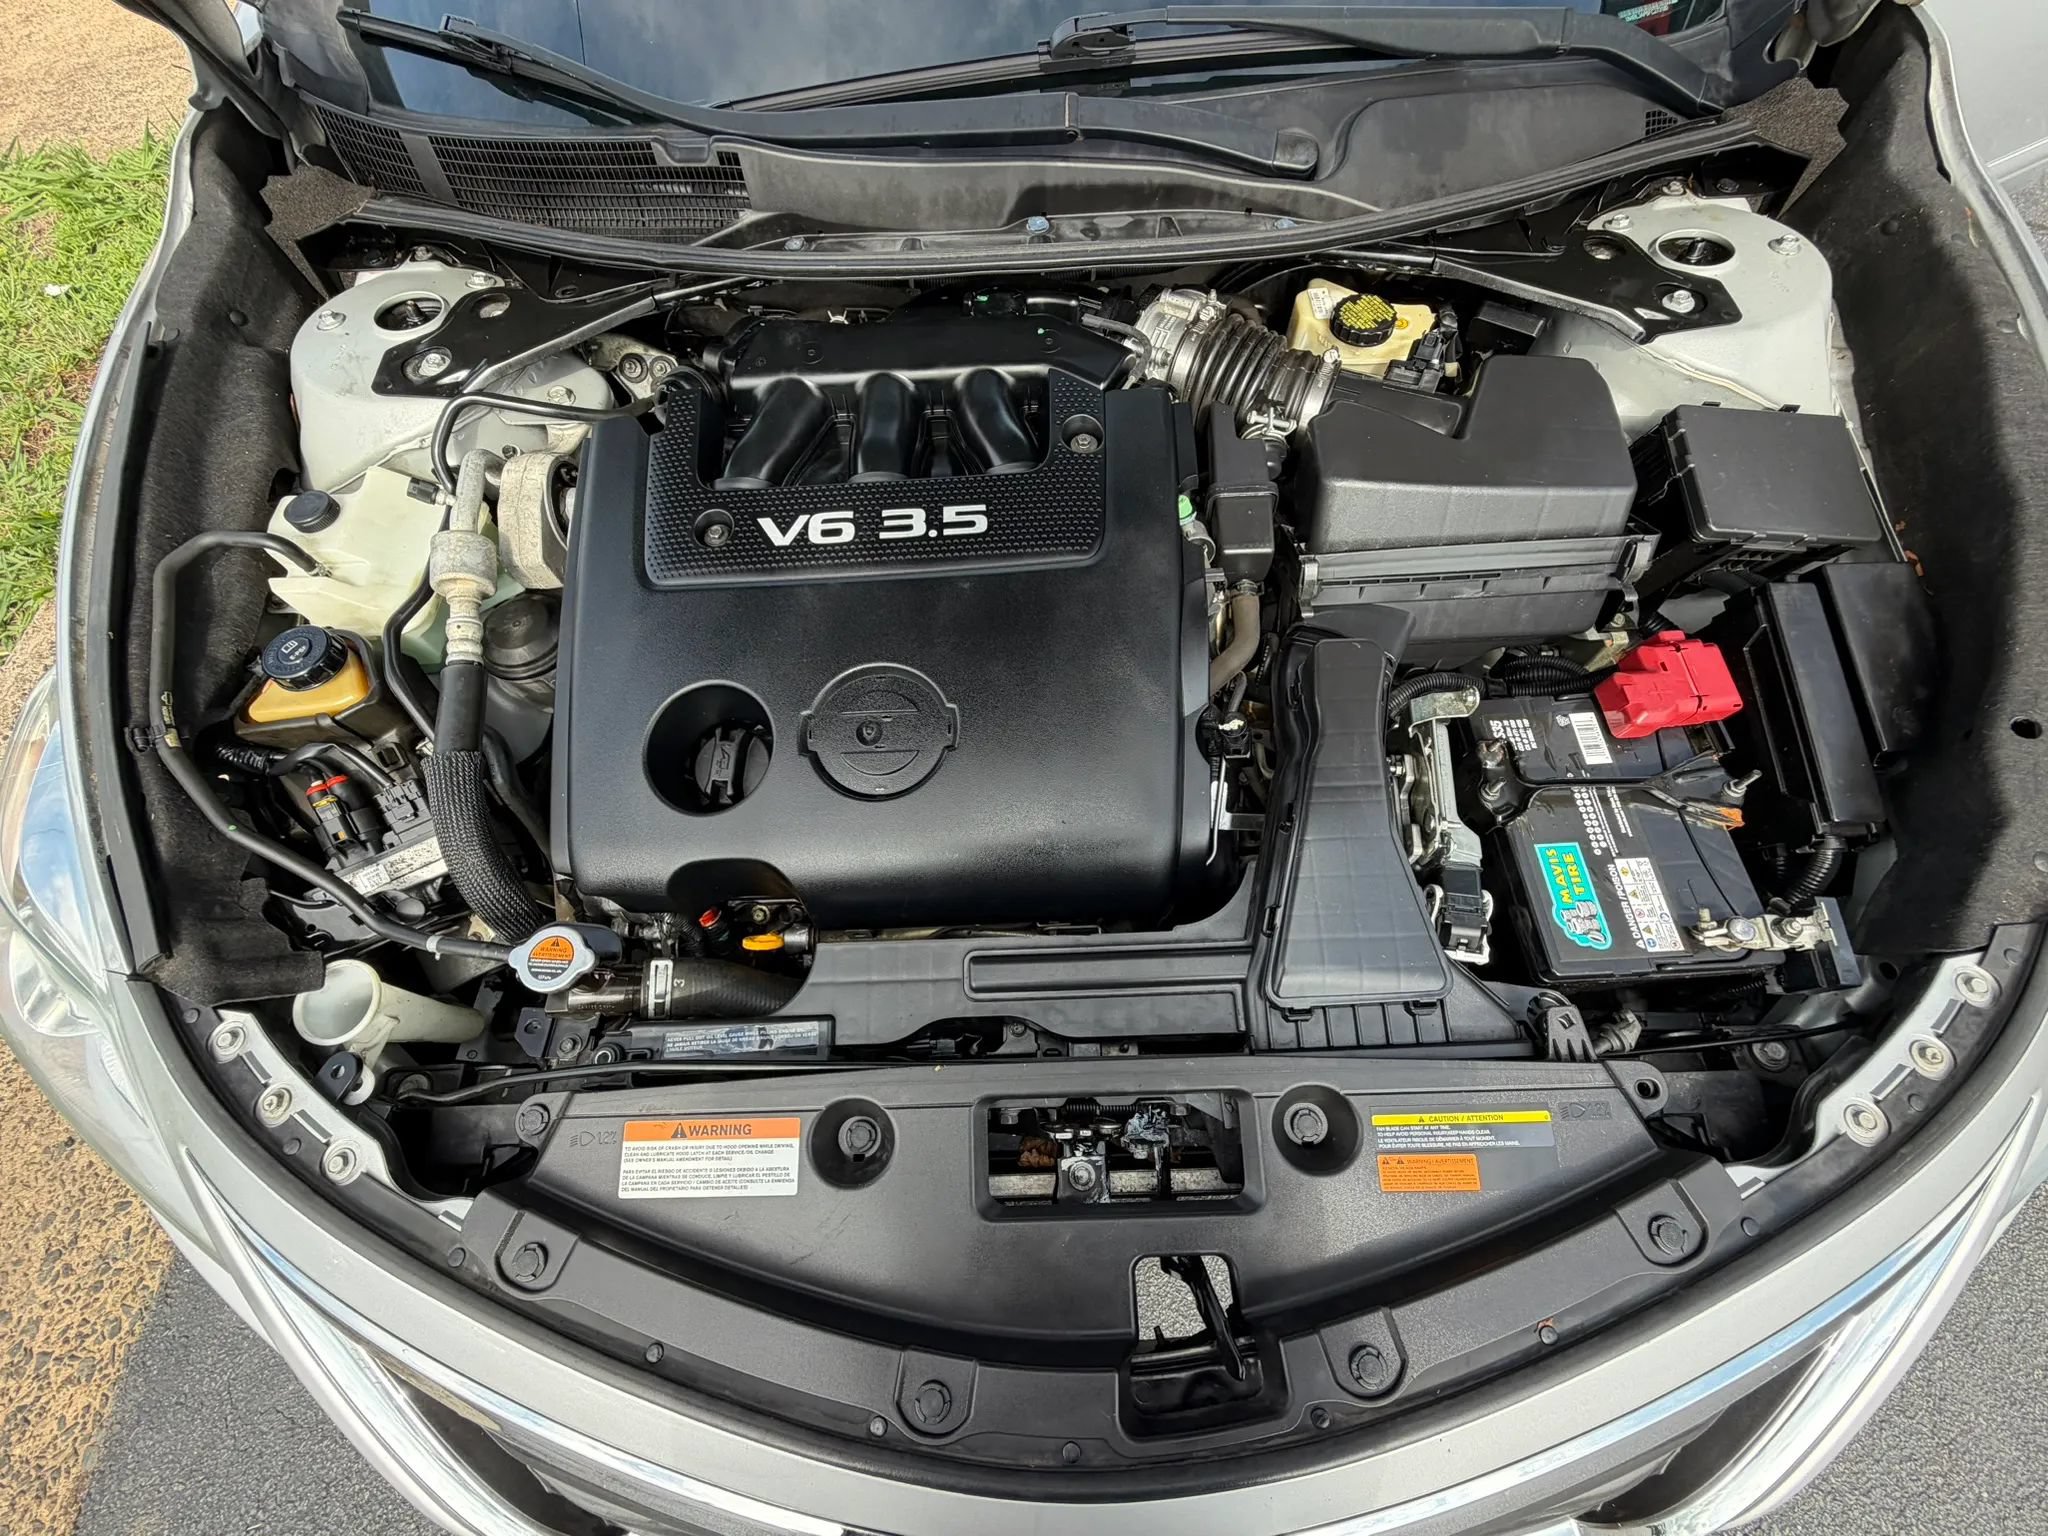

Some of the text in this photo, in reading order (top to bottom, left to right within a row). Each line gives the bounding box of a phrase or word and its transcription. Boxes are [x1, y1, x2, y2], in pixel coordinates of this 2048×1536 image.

[756, 505, 988, 546] V6 3.5
[1546, 849, 1573, 904] MAVIS
[1562, 853, 1584, 896] TIRE
[1621, 901, 1641, 939] DANGER
[689, 1124, 752, 1137] WARNING
